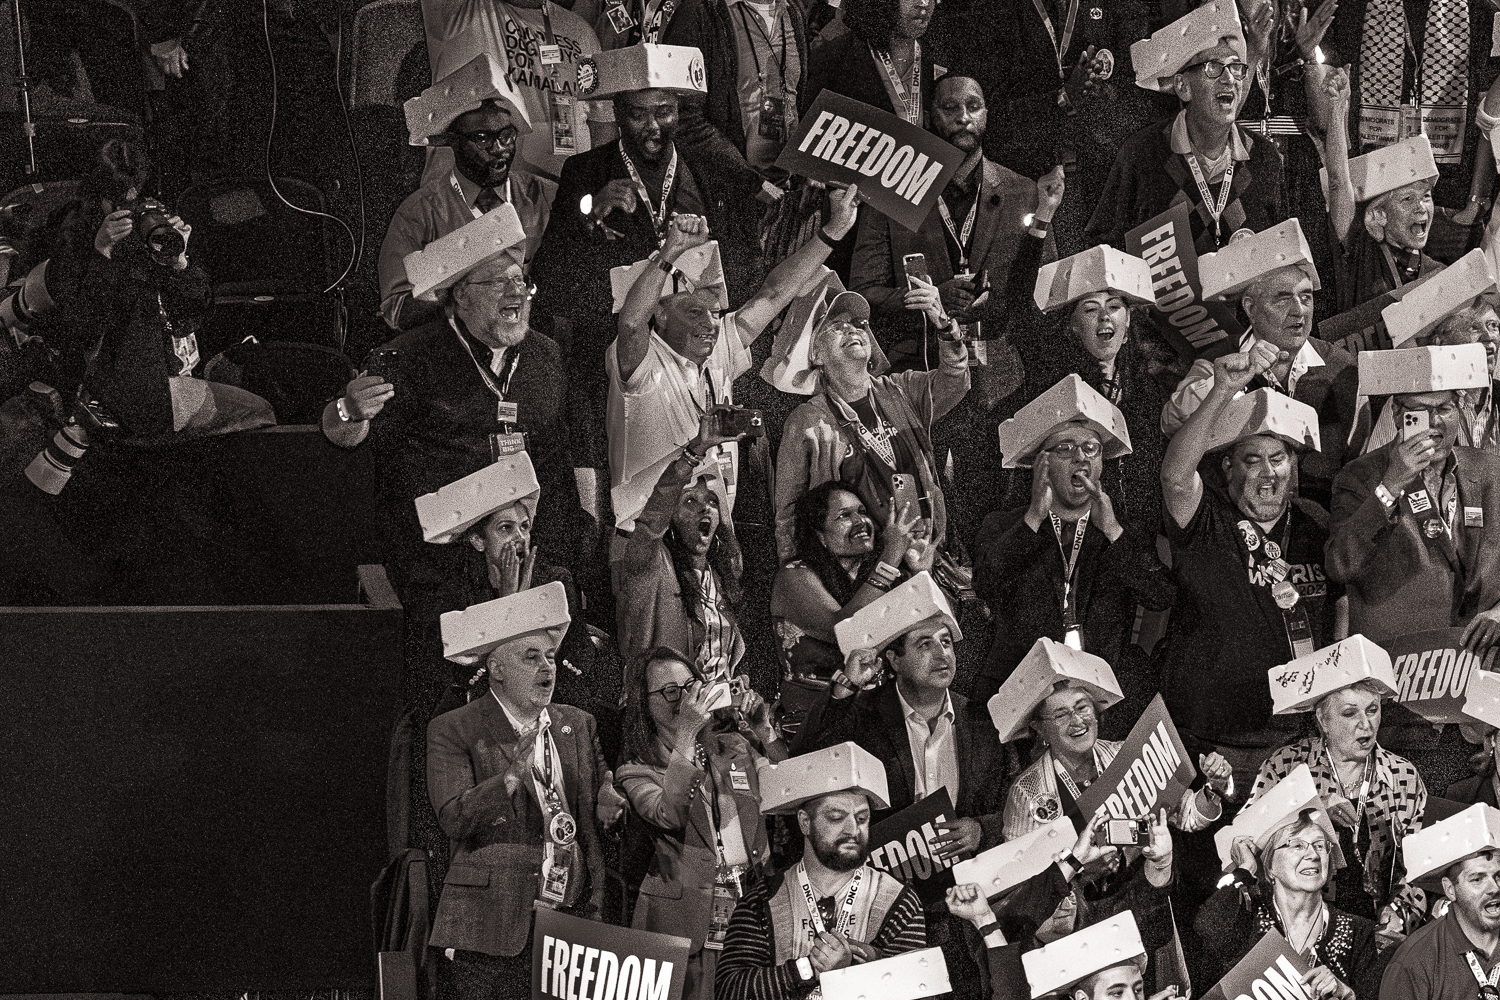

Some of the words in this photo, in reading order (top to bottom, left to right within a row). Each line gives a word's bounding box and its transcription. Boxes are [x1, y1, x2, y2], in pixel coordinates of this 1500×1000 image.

[505, 19, 582, 54] CHILDESS
[798, 110, 943, 204] FREEDOM
[1140, 221, 1229, 347] FREEDOM
